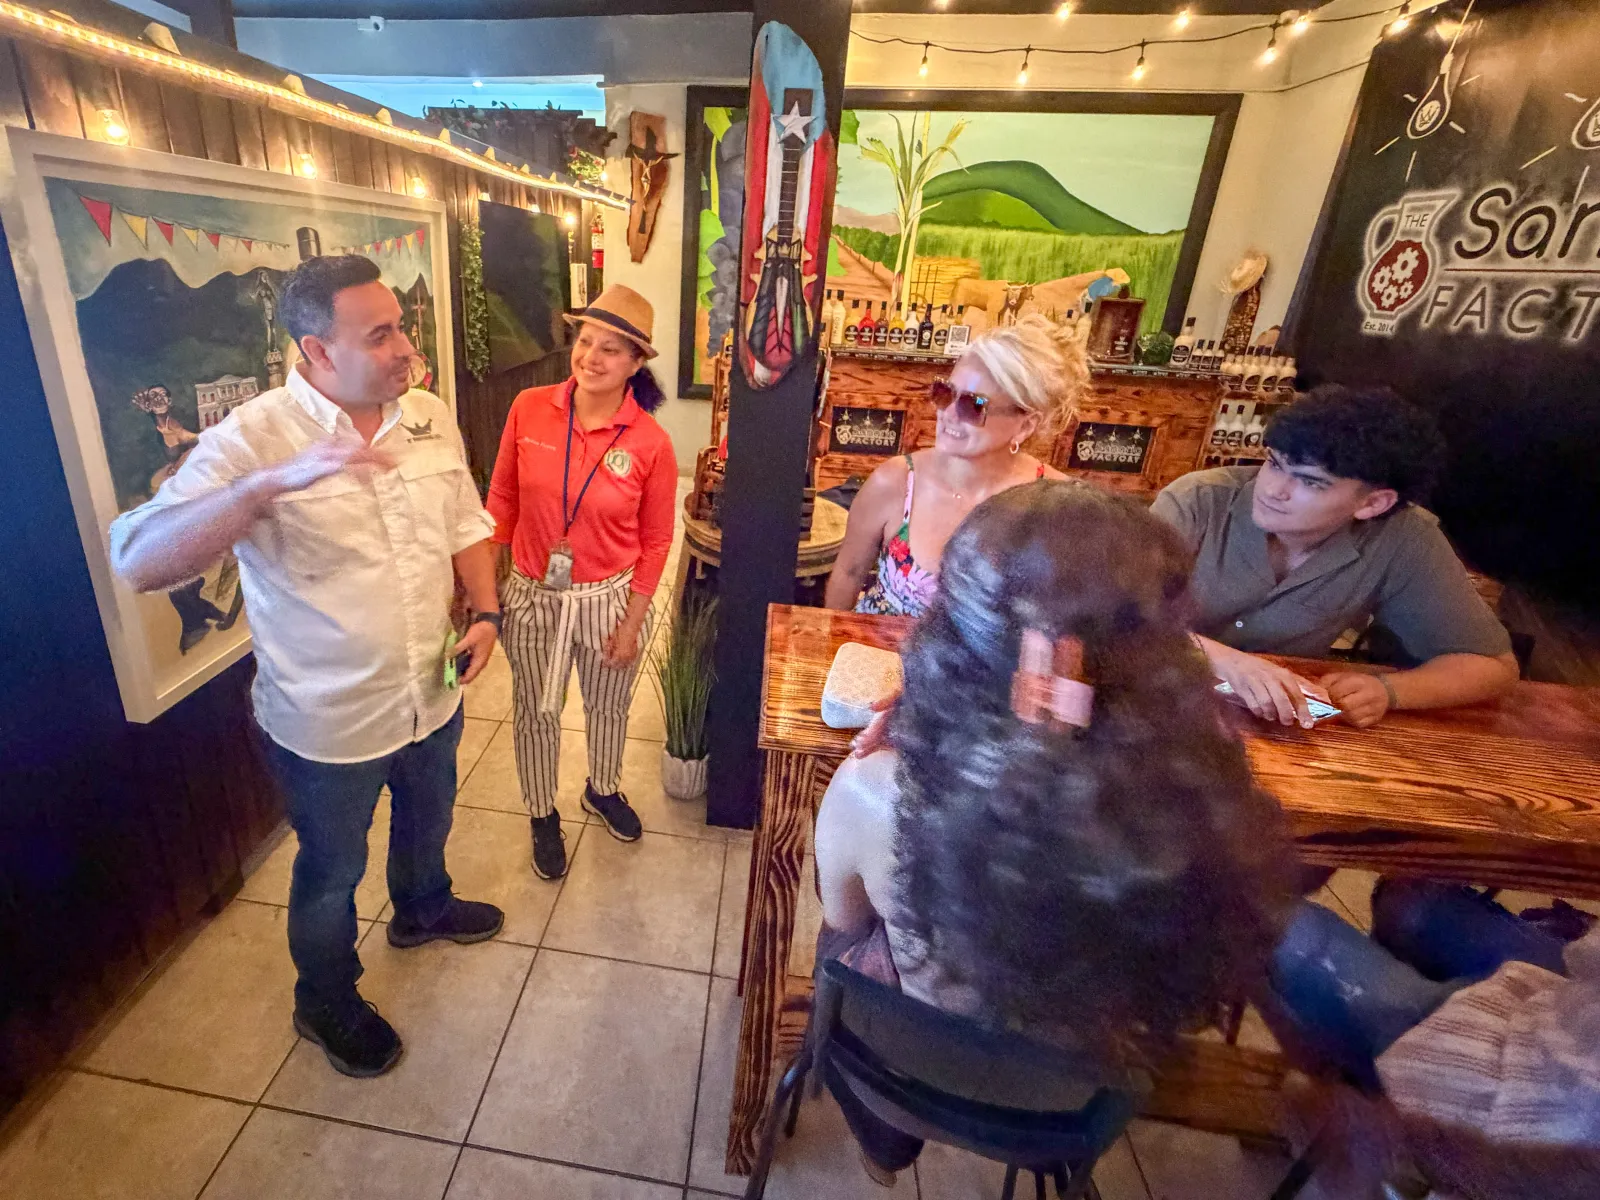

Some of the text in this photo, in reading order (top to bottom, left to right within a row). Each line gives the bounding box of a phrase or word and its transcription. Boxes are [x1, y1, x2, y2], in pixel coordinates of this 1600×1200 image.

[1405, 213, 1430, 228] THE
[1424, 285, 1600, 339] FACT
[1377, 322, 1395, 333] 2014
[849, 437, 895, 447] FACTORY
[1091, 453, 1140, 463] FACTORY
